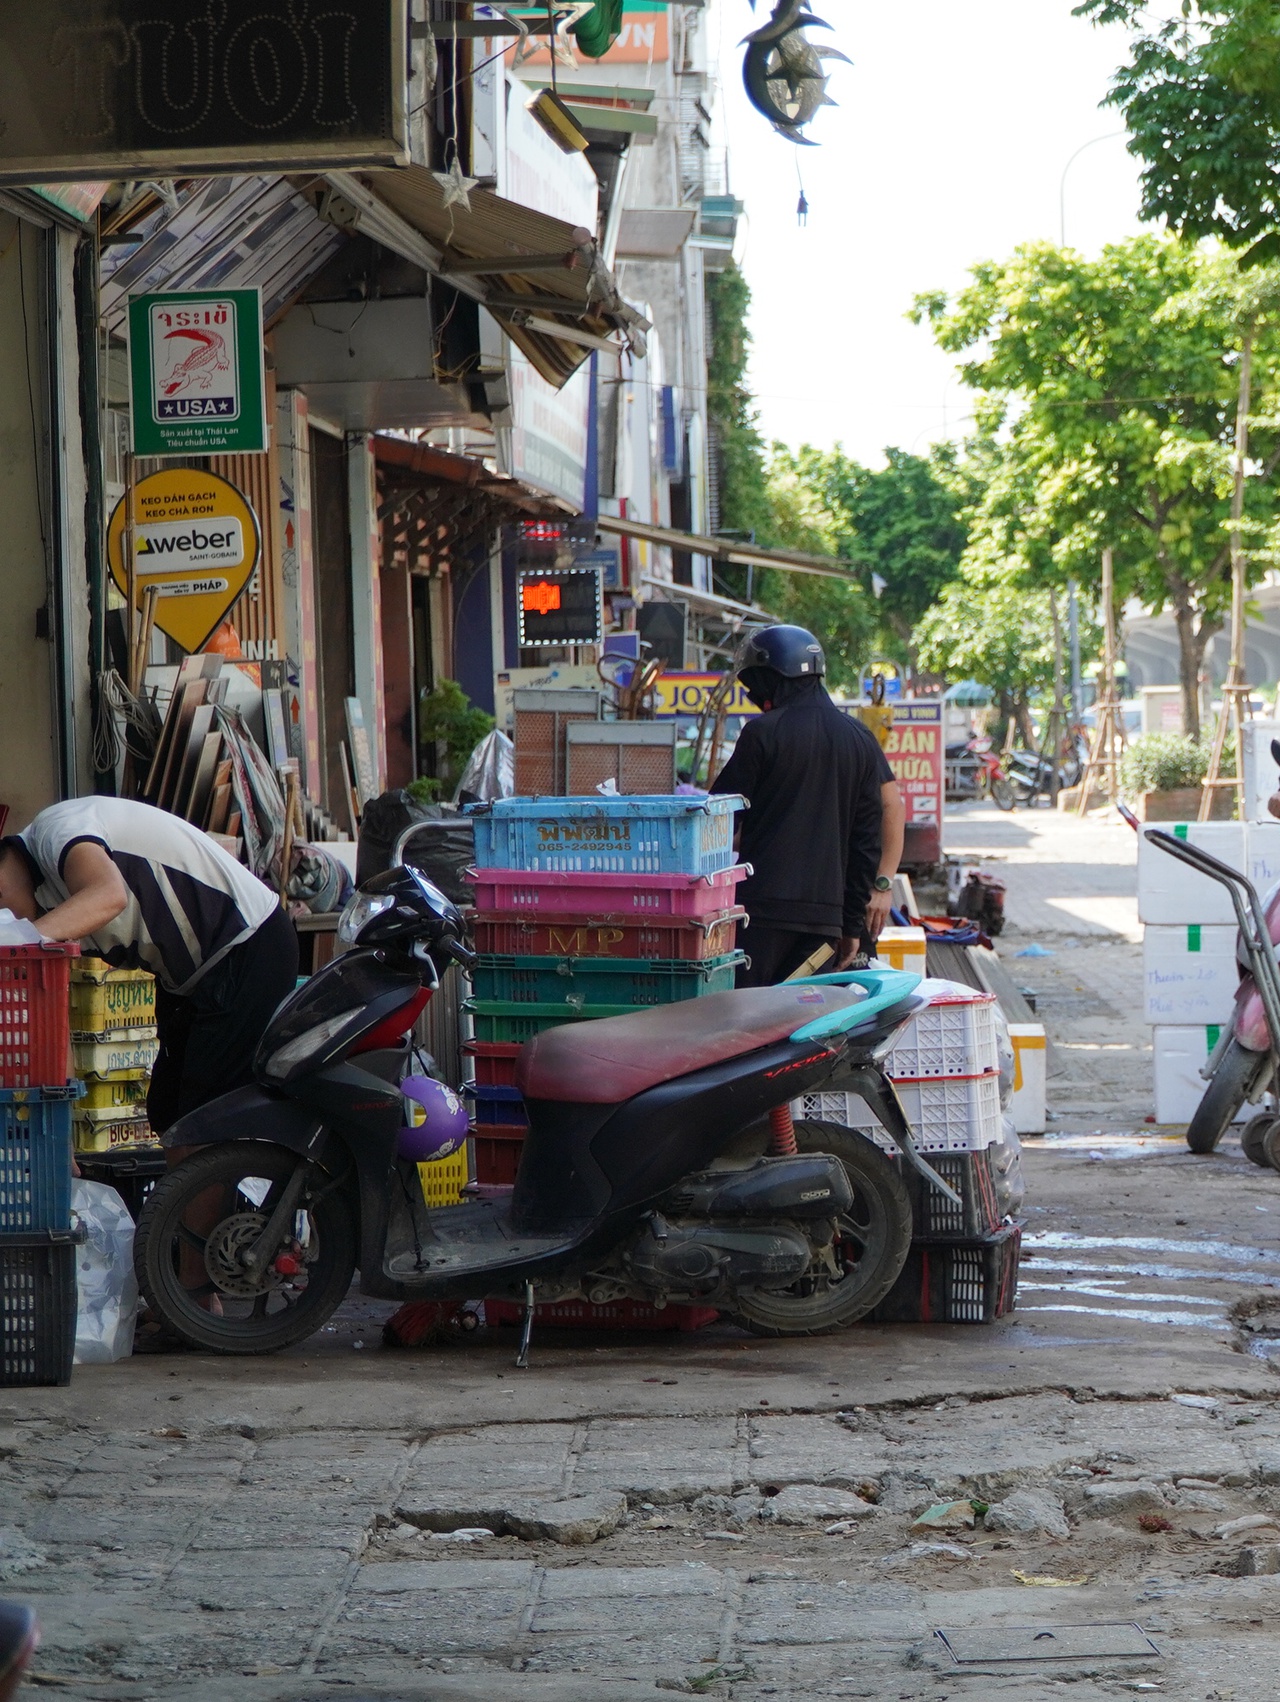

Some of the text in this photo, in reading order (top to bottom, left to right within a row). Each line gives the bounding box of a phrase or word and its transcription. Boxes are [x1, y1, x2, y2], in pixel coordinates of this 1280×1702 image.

[157, 304, 228, 327] จระเข้
[176, 399, 218, 416] USA
[160, 429, 175, 438] Sản
[176, 427, 193, 437] xuất
[194, 428, 204, 437] tại
[206, 427, 223, 435] Thái
[167, 437, 227, 447] Tiêu chuẩn USA
[141, 492, 217, 506] KEO DÁN GẠCH
[145, 505, 214, 518] KEO CHÀ RON
[153, 529, 236, 553] weber
[192, 580, 222, 592] PHÁP
[884, 726, 935, 753] BÁN
[888, 757, 933, 780] HỮA
[537, 842, 632, 851] 065-2492945
[545, 926, 625, 953] MP
